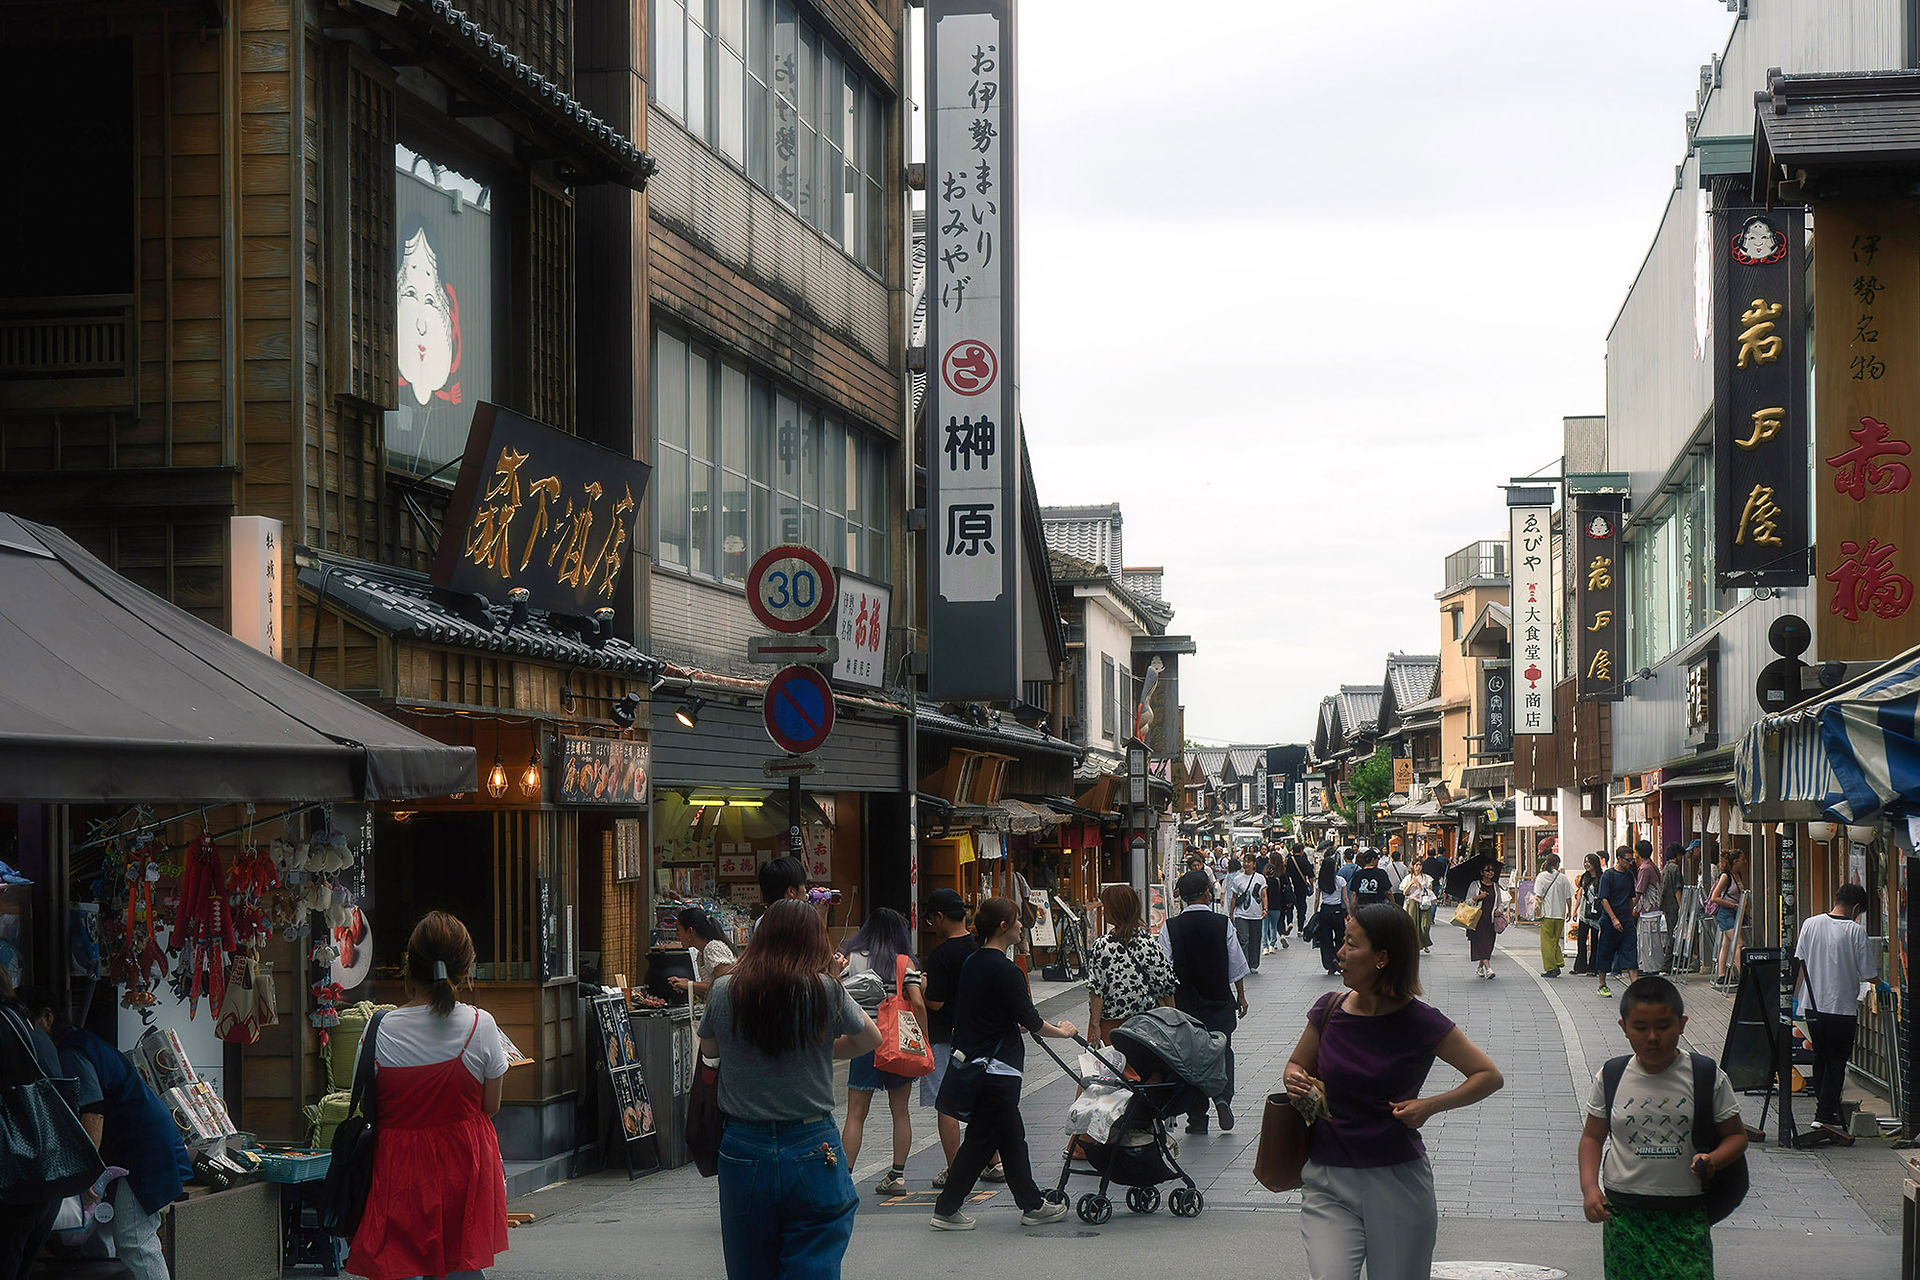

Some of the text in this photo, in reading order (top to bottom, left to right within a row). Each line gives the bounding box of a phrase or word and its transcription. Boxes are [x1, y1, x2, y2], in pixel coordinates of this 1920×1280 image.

[967, 43, 998, 270] お伊勢まいり
[939, 170, 971, 315] おみやげ
[1849, 233, 1886, 381] 伊勢名物
[944, 414, 996, 557] 榊原
[1734, 298, 1785, 548] 岩戸屋
[767, 569, 816, 609] 30
[1825, 416, 1915, 624] 赤福
[855, 592, 881, 653] 赤福
[1523, 514, 1542, 728] ゑびや 大食堂 商店
[1586, 555, 1613, 682] 岩戸屋
[1634, 1145, 1684, 1156] MINECRAFT
